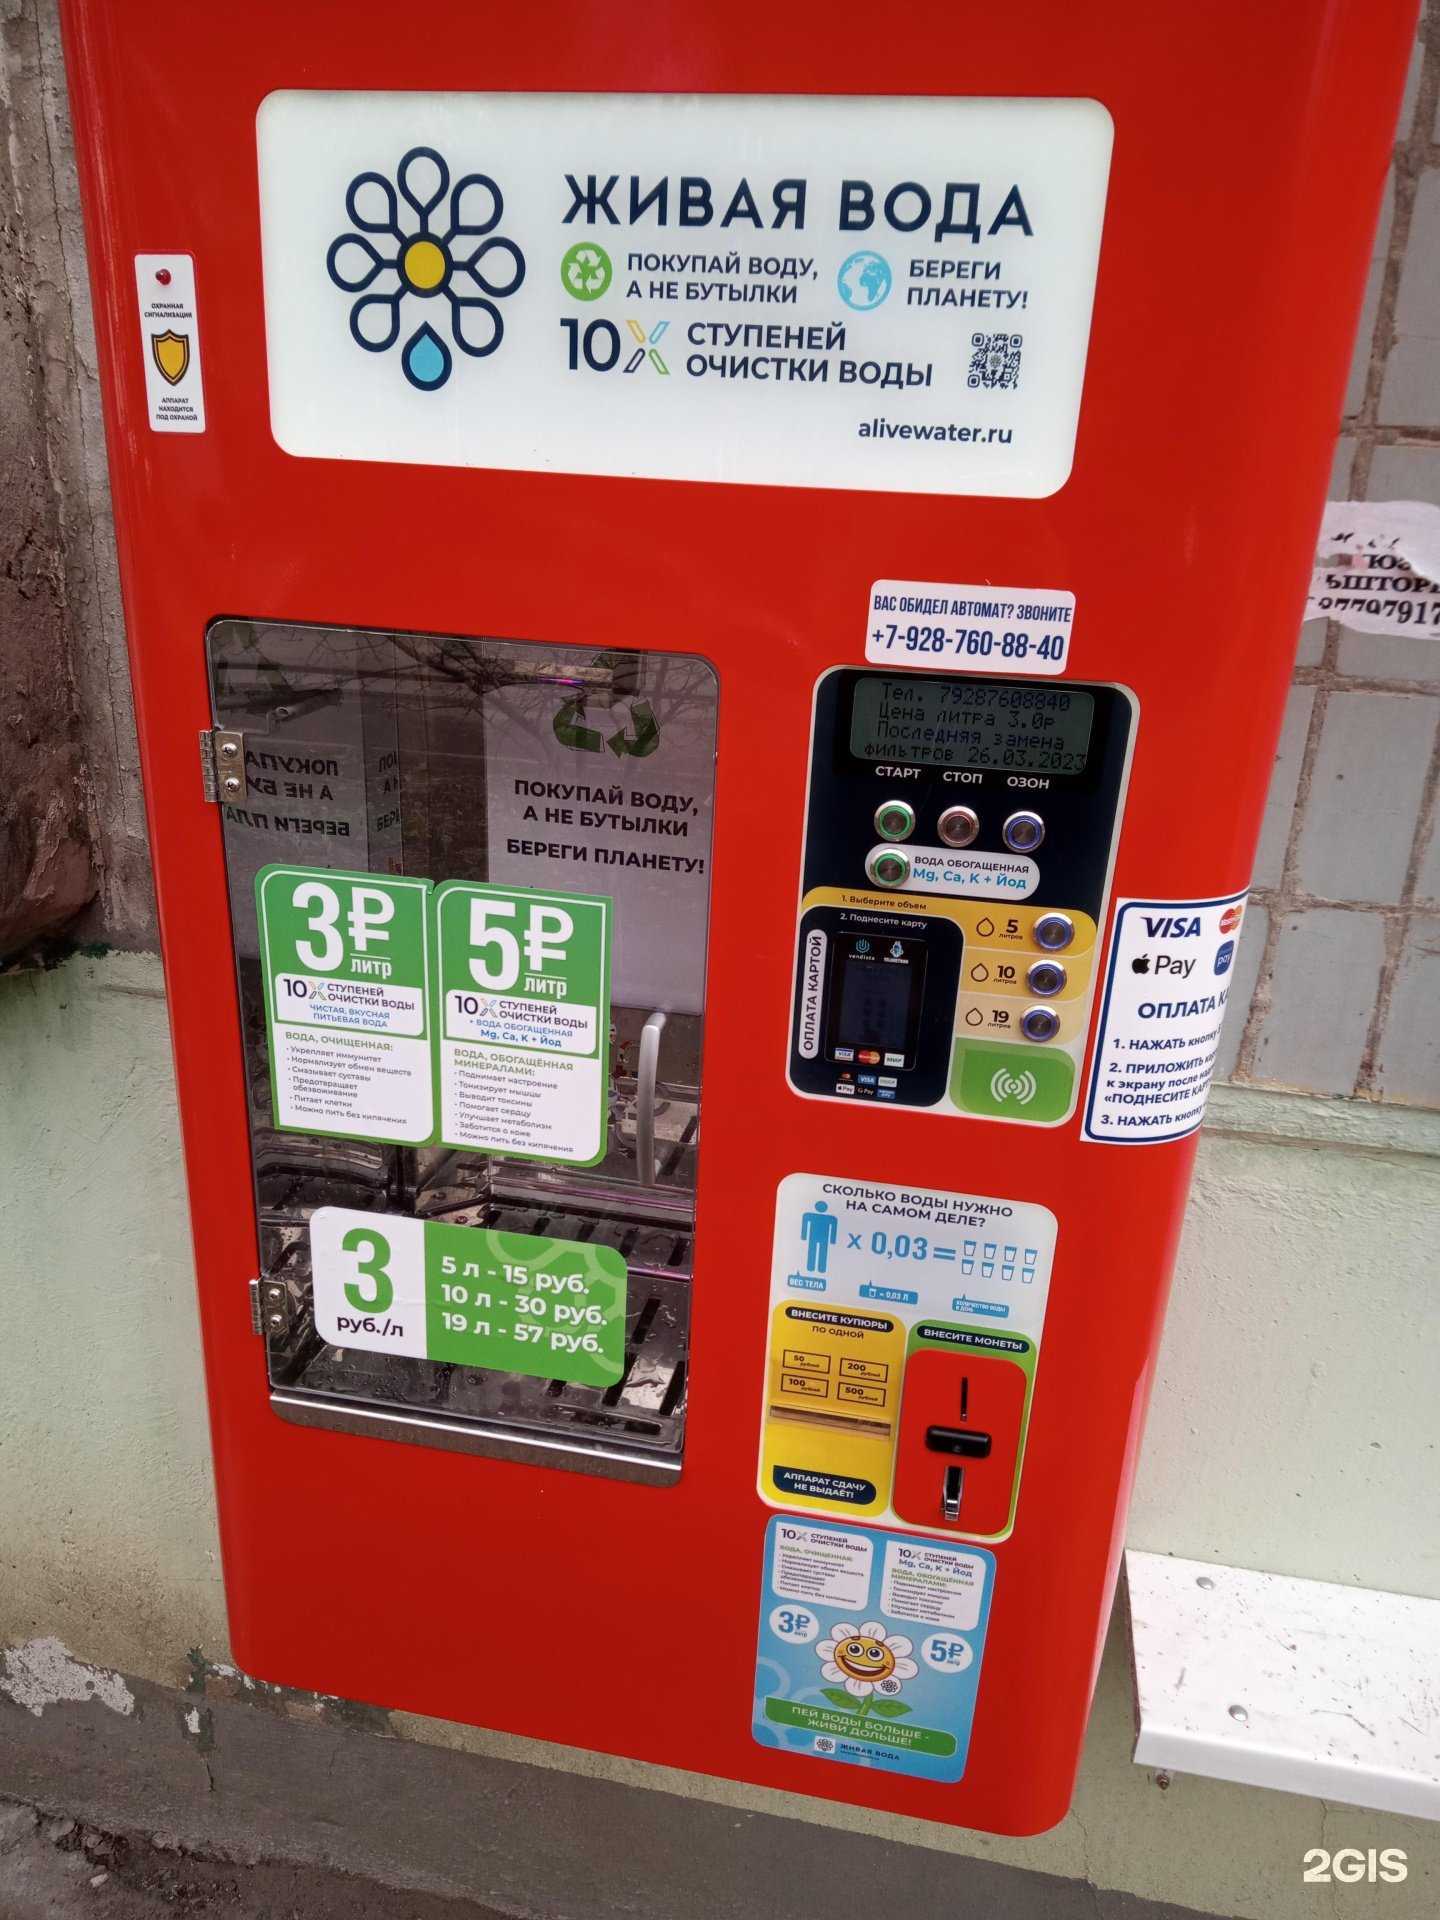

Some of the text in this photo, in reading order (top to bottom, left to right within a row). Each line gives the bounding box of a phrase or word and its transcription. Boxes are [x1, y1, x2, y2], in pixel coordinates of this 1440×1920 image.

[562, 175, 1034, 244] ЖИВАЯ ВОДА
[628, 251, 819, 280] ПОКУПАЙ ВОДУ,
[909, 259, 1001, 280] БЕРЕГИ
[626, 280, 798, 304] А НЕ БУТЫЛКИ
[907, 287, 1029, 309] ПЛАНЕТУ!
[687, 321, 846, 351] СТУПЕНЕЙ
[686, 353, 933, 389] ОЧИСТКИ ВОДЫ
[858, 418, 1013, 443] alivewater.ru
[874, 595, 1072, 622] ВАС ОБИДЕЛ АВТОМАТ? ЗВОНИТЕ
[872, 624, 1064, 661] +7-928-760-88-40
[882, 682, 1071, 711] Тел. 79287608840
[879, 702, 925, 721] Цена
[937, 710, 995, 727] литра
[877, 720, 1065, 750] Последняя замена
[967, 747, 1087, 772] 26.03.2023
[875, 766, 921, 779] СТАРТ
[943, 771, 983, 784] СТОП
[1007, 776, 1050, 789] ОЗОН
[514, 779, 698, 816] ПОКУПАЙ ВОДУ,
[523, 806, 688, 837] А НЕ БУТЫЛКИ
[507, 839, 704, 875] БЕРЕГИ ПЛАНЕТУ!
[915, 856, 944, 866] ВОДА
[913, 868, 939, 881] Mg,
[996, 874, 1026, 889] Йод
[849, 897, 895, 907] Выберите
[850, 914, 928, 929] Поднесите карту
[1006, 919, 1018, 933] 5
[1141, 916, 1201, 938] VISA
[350, 958, 392, 979] литр
[997, 965, 1015, 979] 10
[1154, 955, 1197, 979] Pay
[327, 983, 384, 997] СТУПЕНЕЙ
[524, 976, 567, 1000] литр
[804, 936, 822, 1051] ОПЛАТА КАРТОЙ
[310, 1004, 390, 1019] ЧИСТАЯ, ВКУСНАЯ
[328, 993, 415, 1010] ОЧИСТКИ ВОДЫ
[499, 1000, 557, 1015] СТУПЕНЕЙ
[1138, 994, 1216, 1019] ОПЛАТА
[313, 1013, 388, 1028] ПИТЬЕВАЯ ВОДА
[476, 1019, 502, 1029] ВОДА
[499, 1010, 588, 1029] ОЧИСТКИ ВОДЫ
[992, 1009, 1009, 1023] 19
[285, 1032, 319, 1044] ВОДА,
[480, 1029, 499, 1040] Mg,
[540, 1035, 562, 1048] Йод
[1114, 1030, 1216, 1050] 1. НАЖАТЬ кнопку
[454, 1048, 488, 1060] ВОДА,
[454, 1059, 535, 1077] МИНЕРАЛАМИ:
[1109, 1057, 1204, 1074] 2. ПРИЛОЖИТЬ
[1118, 1080, 1165, 1092] экрану
[1168, 1074, 1198, 1088] после
[1104, 1089, 1190, 1106] «ПОДНЕСИТЕ
[1101, 1106, 1202, 1126] 3. НАЖАТЬ кнопку
[822, 1183, 1013, 1218] СКОЛЬКО ВОДЫ НУЖНО
[846, 1199, 986, 1228] НА САМОМ ДЕЛЕ?
[871, 1231, 928, 1261] 0,03
[342, 1227, 394, 1314] 3
[441, 1255, 590, 1295] 5 л 15 руб.
[441, 1283, 608, 1327] 10 л 30 руб.
[336, 1314, 404, 1338] руб./л
[791, 1309, 888, 1331] ВНЕСИТЕ КУПЮРЫ
[441, 1312, 604, 1354] 19 л 57 руб.
[812, 1325, 864, 1340] ПО ОДНОЙ
[924, 1328, 1023, 1350] ВНЕСИТЕ МОНЕТЫ
[794, 1354, 805, 1362] 50
[847, 1362, 866, 1372] 200
[789, 1378, 806, 1387] 100
[845, 1387, 864, 1396] 500
[784, 1472, 866, 1491] АППАРАТ СДАЧУ
[794, 1483, 807, 1491] НЕ
[792, 1706, 922, 1739] ПЕЙ ВОДЫ БОЛЬШЕ
[807, 1718, 912, 1746] ЖИВИ ДОЛЬШЕ!
[840, 1744, 873, 1755] ЖИВАЯ
[875, 1751, 900, 1761] ВОДА
